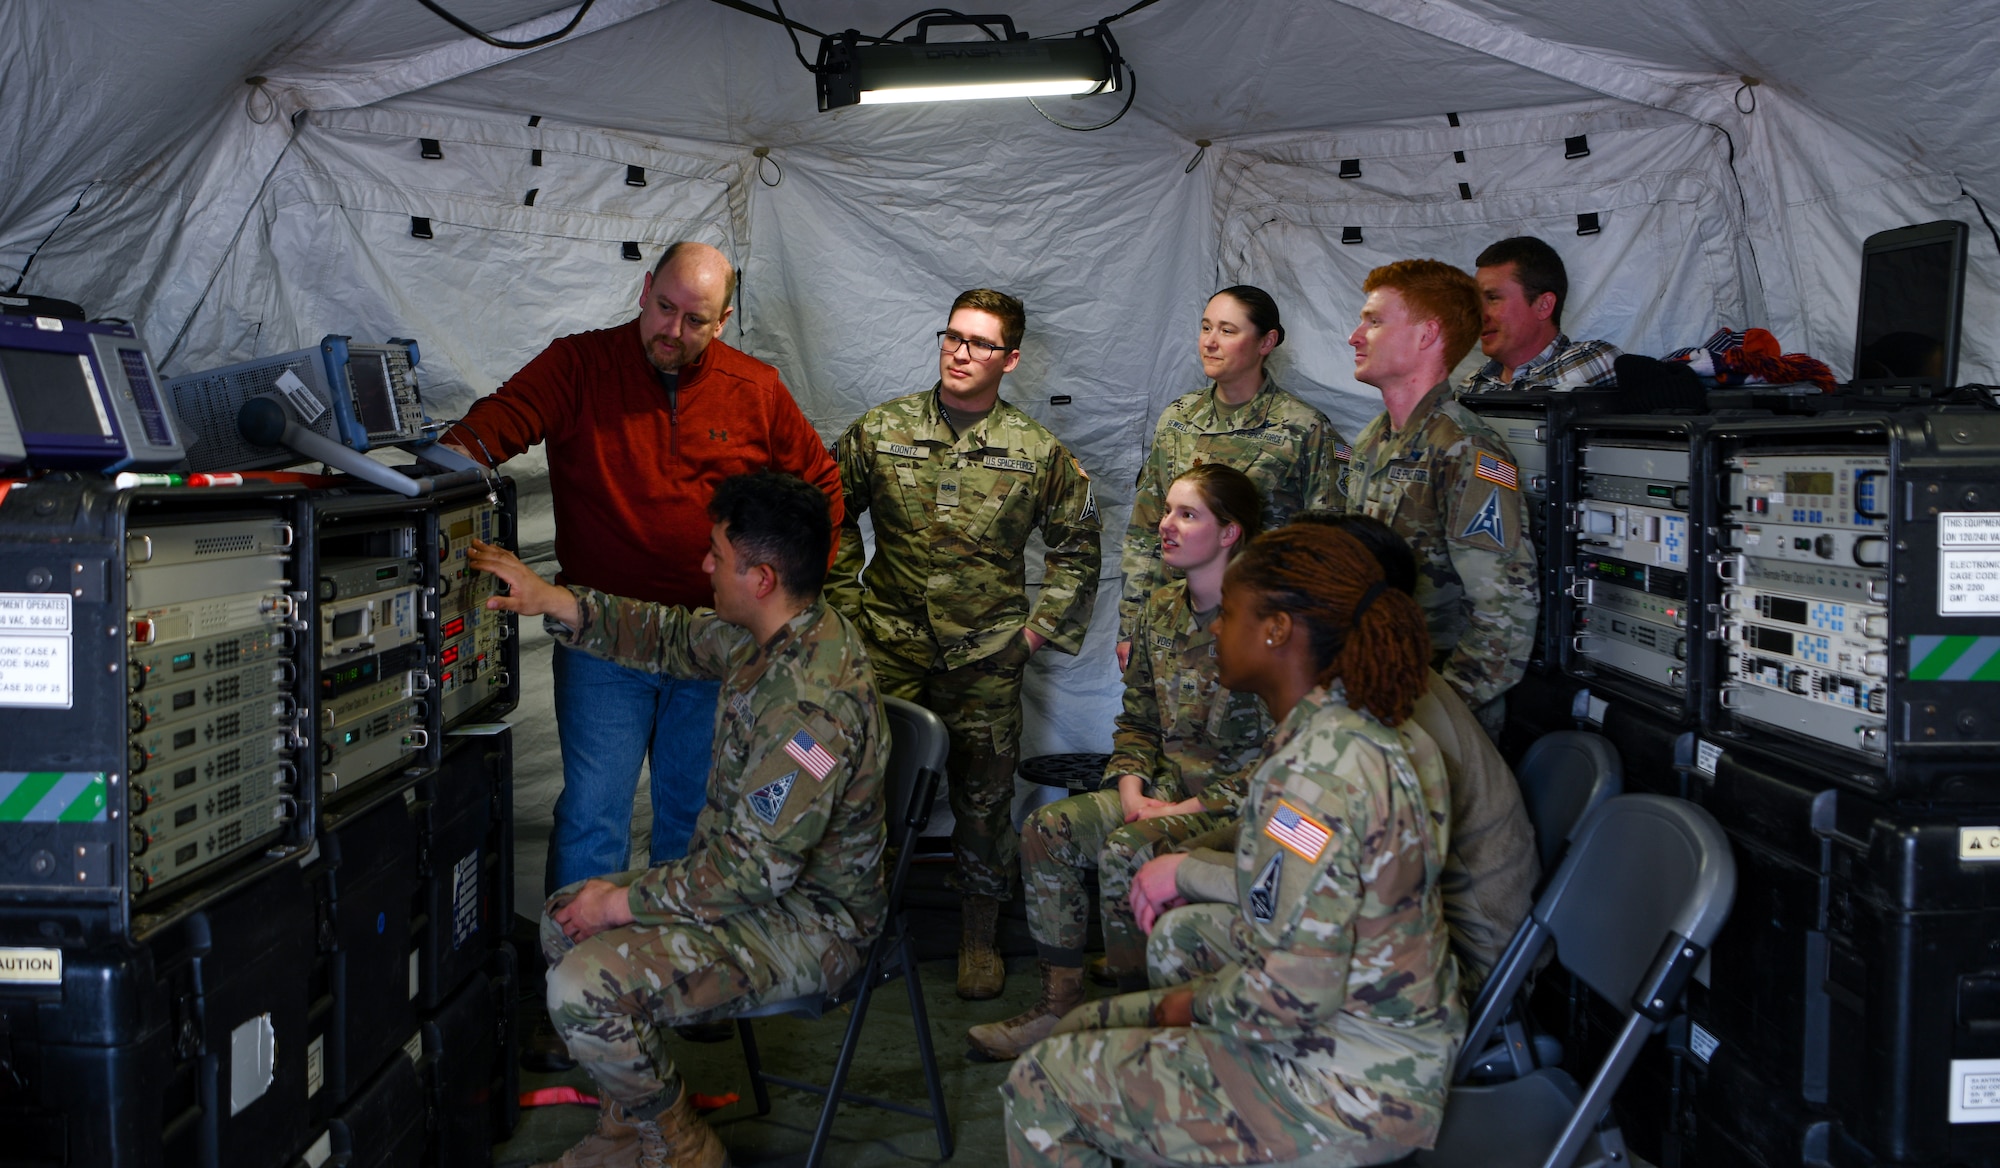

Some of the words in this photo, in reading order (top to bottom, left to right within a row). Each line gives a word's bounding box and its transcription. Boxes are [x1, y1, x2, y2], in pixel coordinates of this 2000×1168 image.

[1167, 420, 1189, 433] SEWELL
[1263, 432, 1282, 444] FORCE
[890, 443, 919, 456] KOONTZ
[985, 456, 996, 466] U.S.
[997, 458, 1017, 469] SPACE
[1016, 460, 1035, 471] FORCE
[1946, 519, 1962, 528] THIS
[1946, 532, 1957, 542] ON
[1960, 532, 1988, 542] 120/240
[1949, 572, 1972, 580] CAGE
[1949, 583, 1963, 592] S/N
[1967, 583, 1985, 592] 2200
[1949, 594, 1968, 602] GMT
[26, 600, 66, 611] OPERATES
[30, 616, 53, 626] 50-60
[55, 616, 66, 625] HZ
[24, 646, 48, 656] CASE
[51, 648, 57, 656] A
[24, 683, 33, 692] 20
[36, 684, 47, 692] OF
